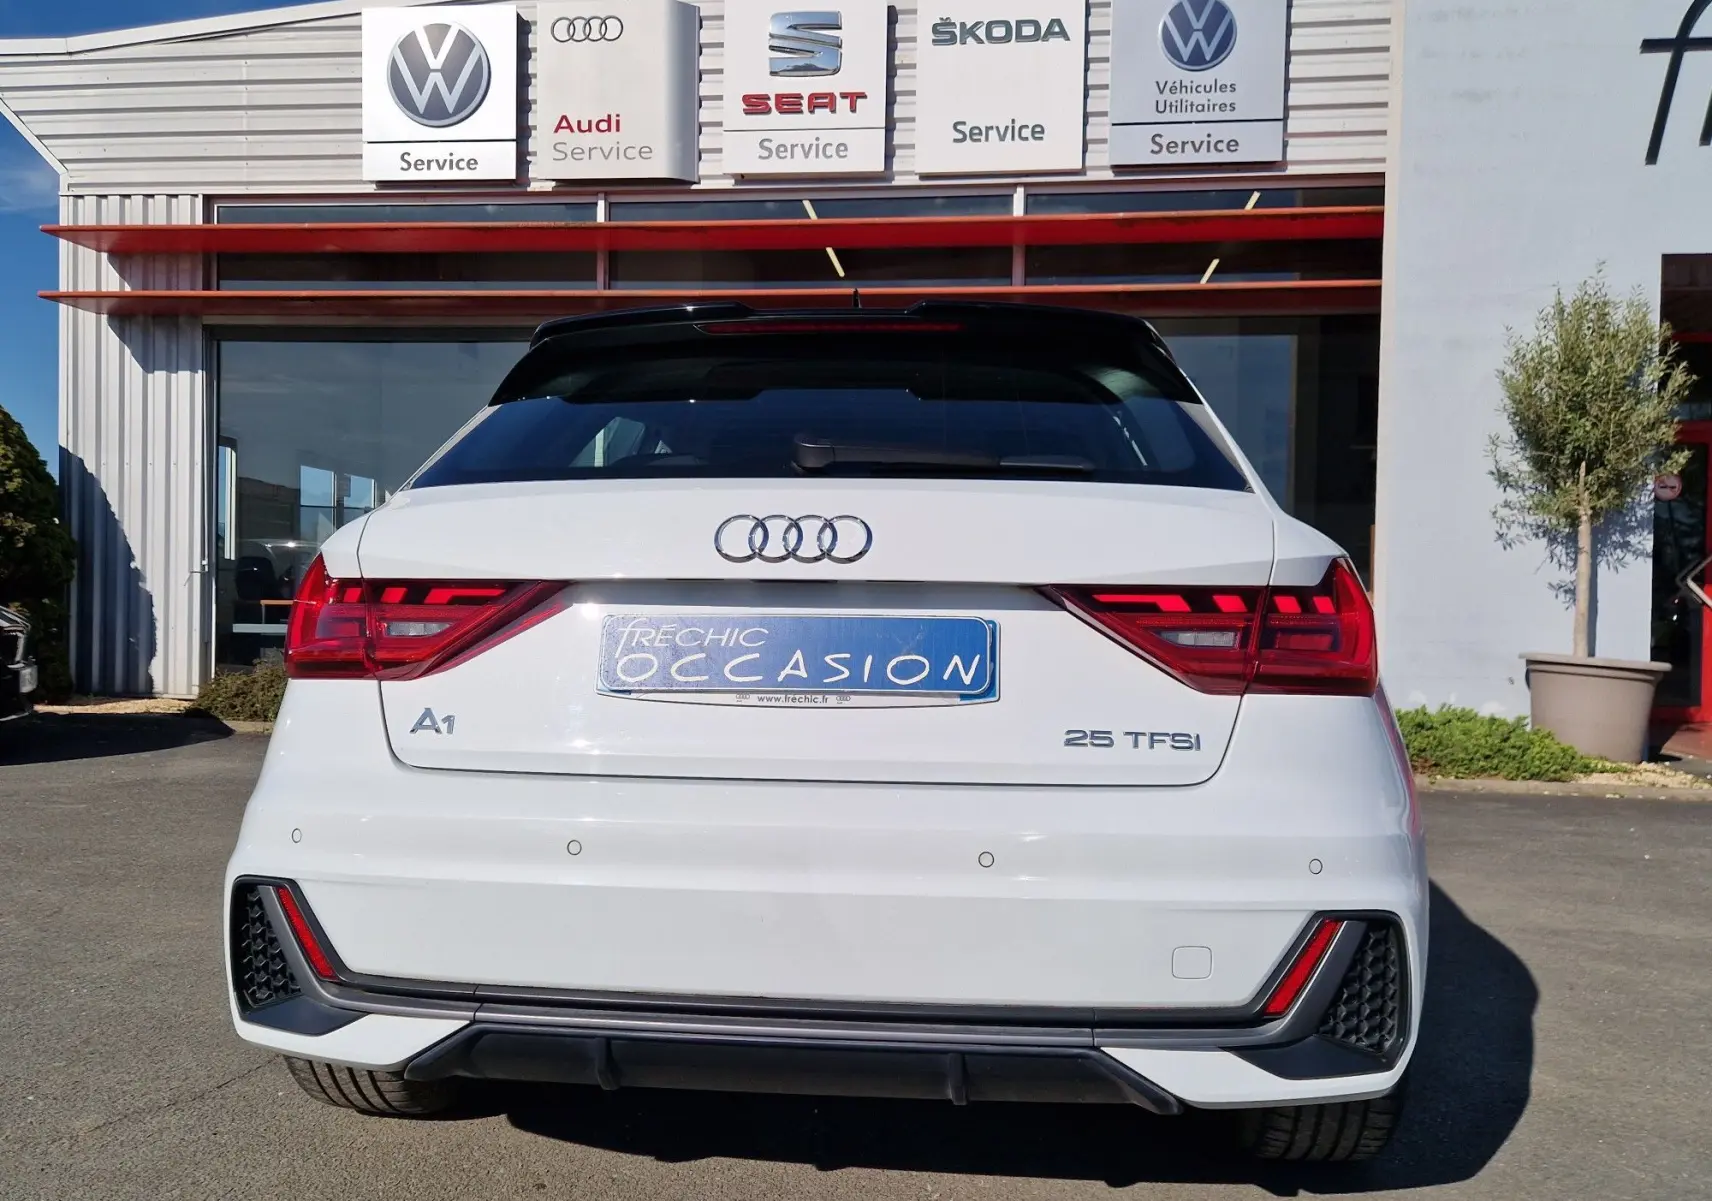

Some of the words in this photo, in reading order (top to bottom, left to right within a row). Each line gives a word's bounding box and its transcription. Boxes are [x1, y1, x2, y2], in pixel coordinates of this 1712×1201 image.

[931, 17, 1071, 46] ŠKODA
[1155, 78, 1237, 95] Véhicules
[741, 91, 867, 115] SEAT
[1155, 99, 1237, 114] Utilitaires
[553, 114, 621, 134] Audi
[952, 118, 1046, 144] Service
[552, 142, 653, 162] Service
[758, 137, 849, 161] Service
[1149, 133, 1240, 155] Service
[399, 151, 480, 172] Service
[615, 649, 982, 685] OCCASION
[409, 707, 456, 735] A1
[1063, 729, 1115, 748] 25
[1122, 731, 1201, 751] TFSI
